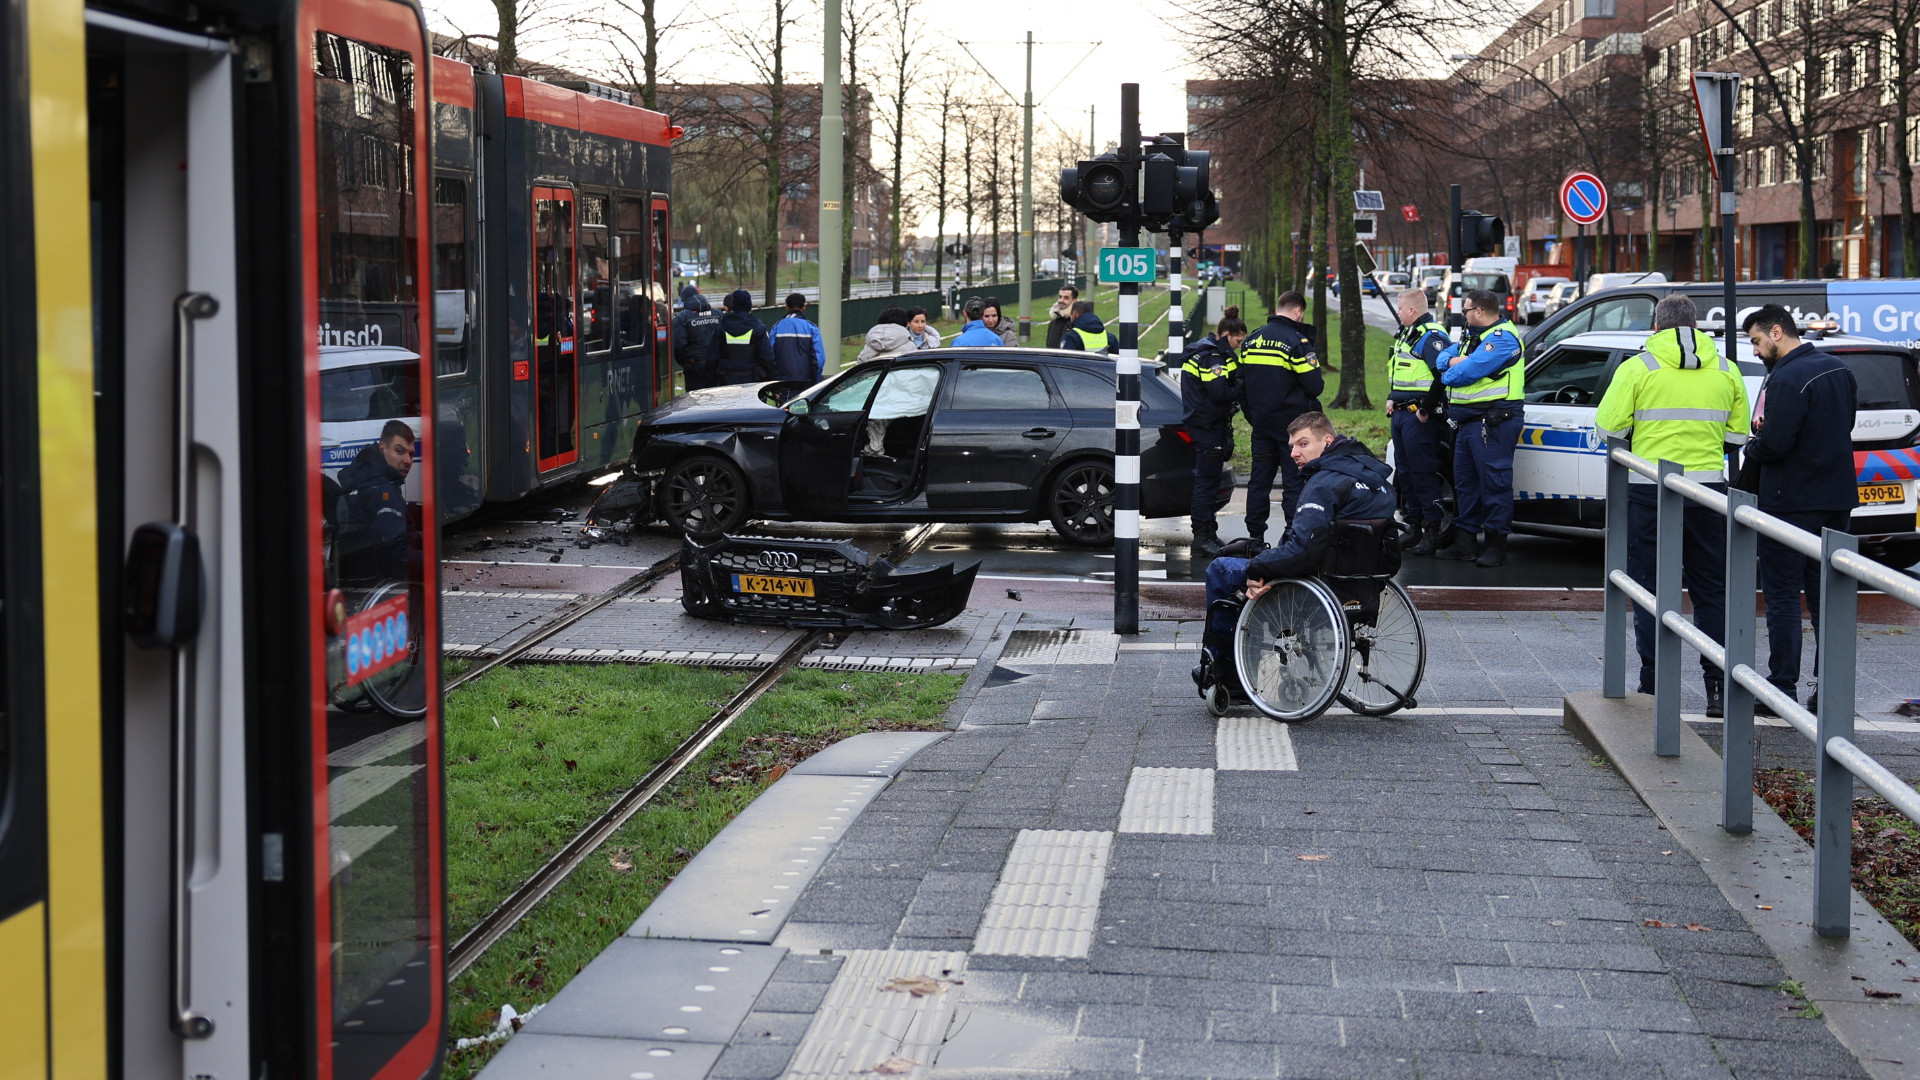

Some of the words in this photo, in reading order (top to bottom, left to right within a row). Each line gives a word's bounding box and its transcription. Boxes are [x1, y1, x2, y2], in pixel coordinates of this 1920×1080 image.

[1105, 254, 1148, 276] 105
[691, 317, 719, 327] Controle
[1858, 486, 1902, 500] -690-RZ
[746, 577, 806, 593] K-214-VV
